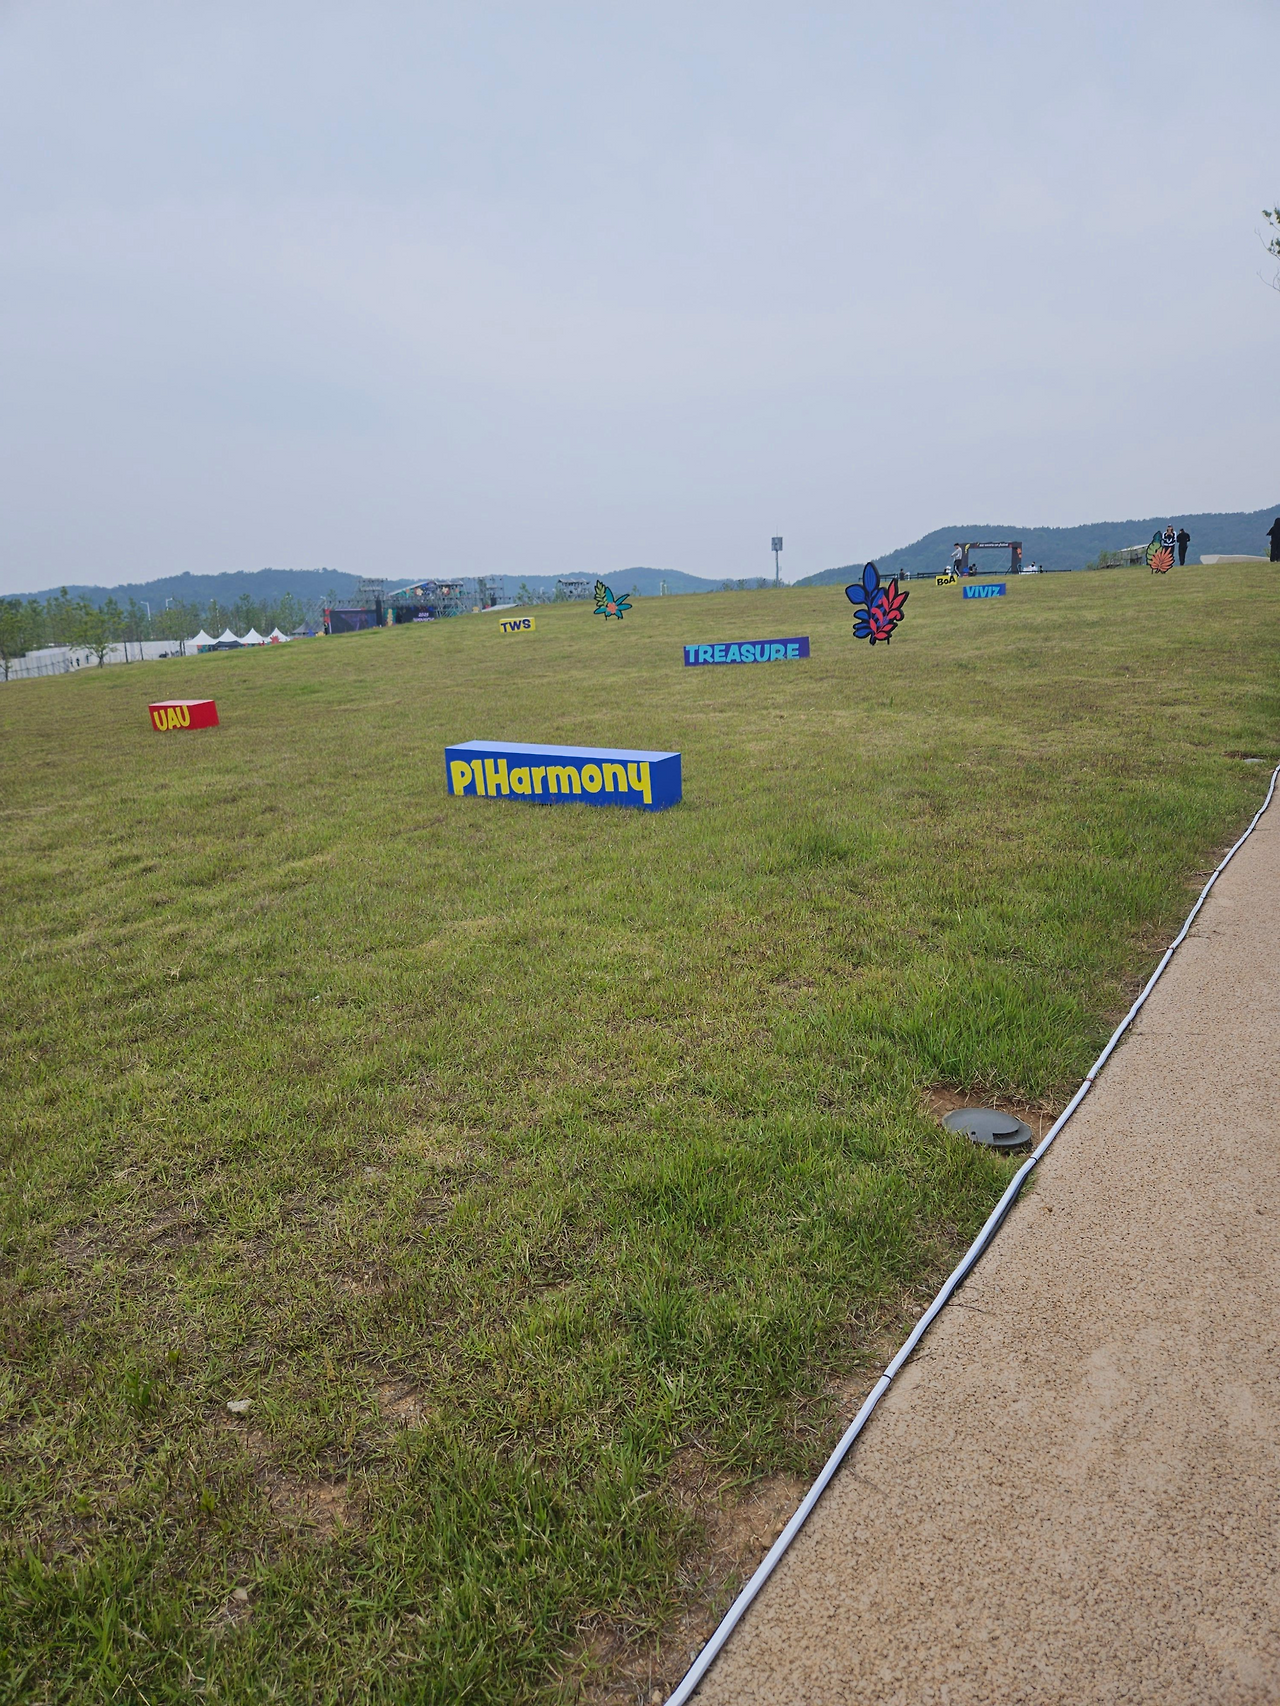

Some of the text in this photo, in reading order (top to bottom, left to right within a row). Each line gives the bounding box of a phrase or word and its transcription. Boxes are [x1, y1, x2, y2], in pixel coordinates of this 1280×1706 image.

[937, 575, 956, 586] BoA
[965, 586, 1001, 598] VIVIZ
[500, 618, 531, 633] TWS
[685, 643, 800, 663] TREASURE
[153, 704, 191, 731] UAU
[450, 758, 652, 804] P1Harmony
